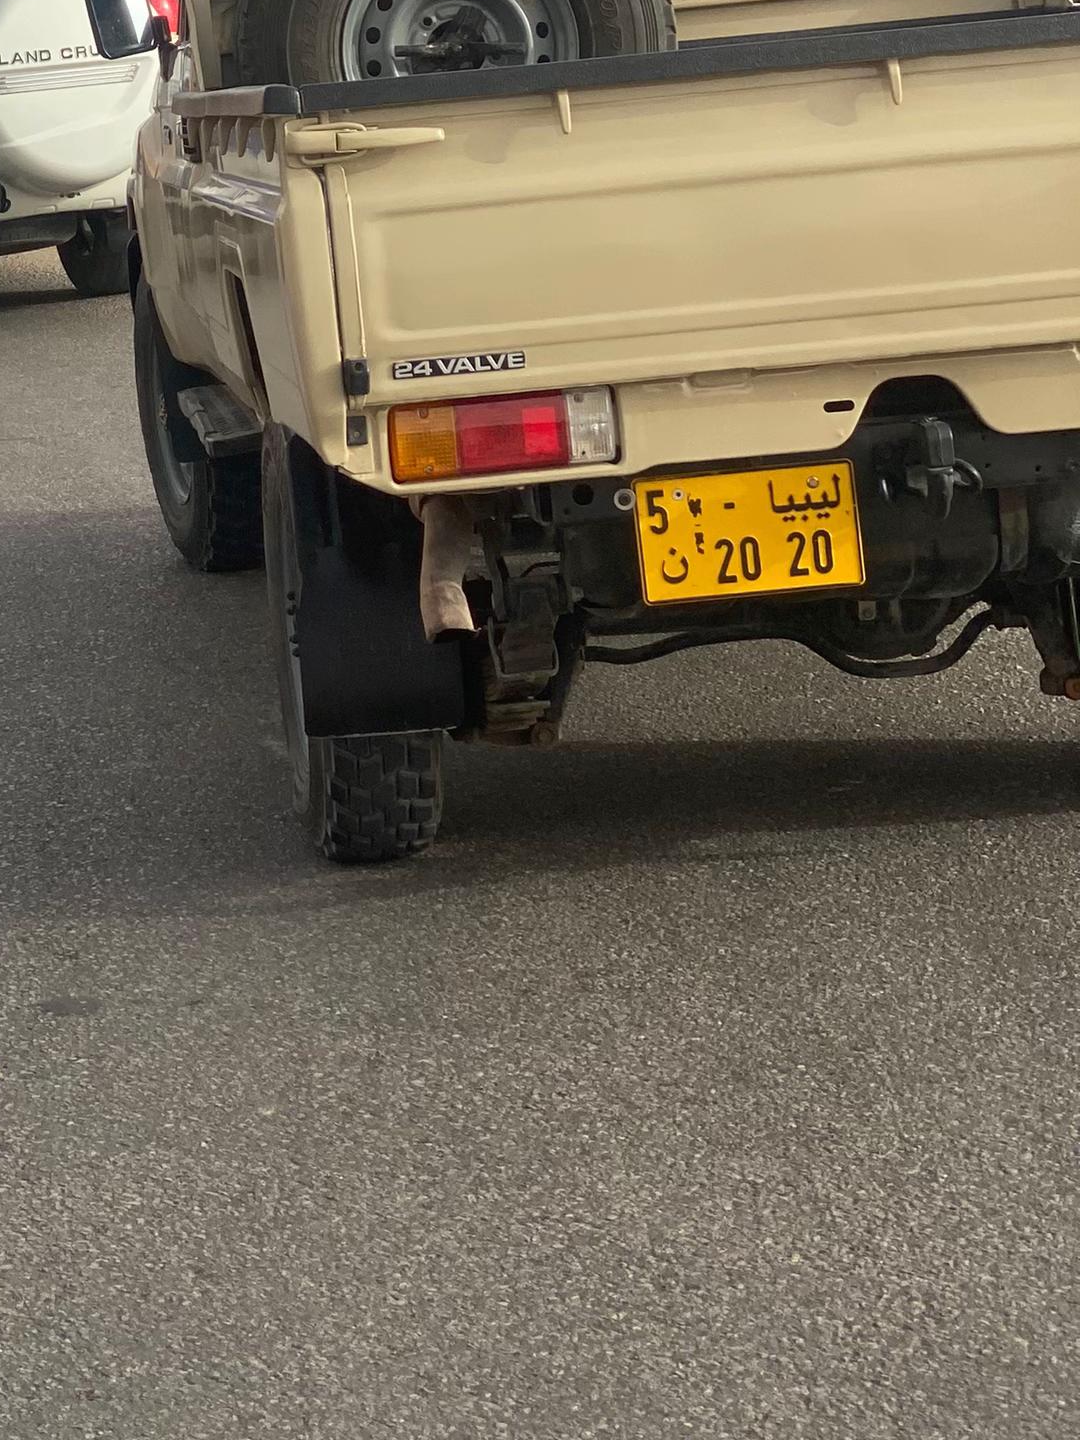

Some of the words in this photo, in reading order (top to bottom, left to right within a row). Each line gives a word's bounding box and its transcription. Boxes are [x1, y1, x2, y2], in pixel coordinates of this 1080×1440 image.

[394, 360, 433, 379] 24
[436, 353, 525, 375] VALVE
[645, 489, 669, 535] 5
[767, 473, 841, 523] ليبيا
